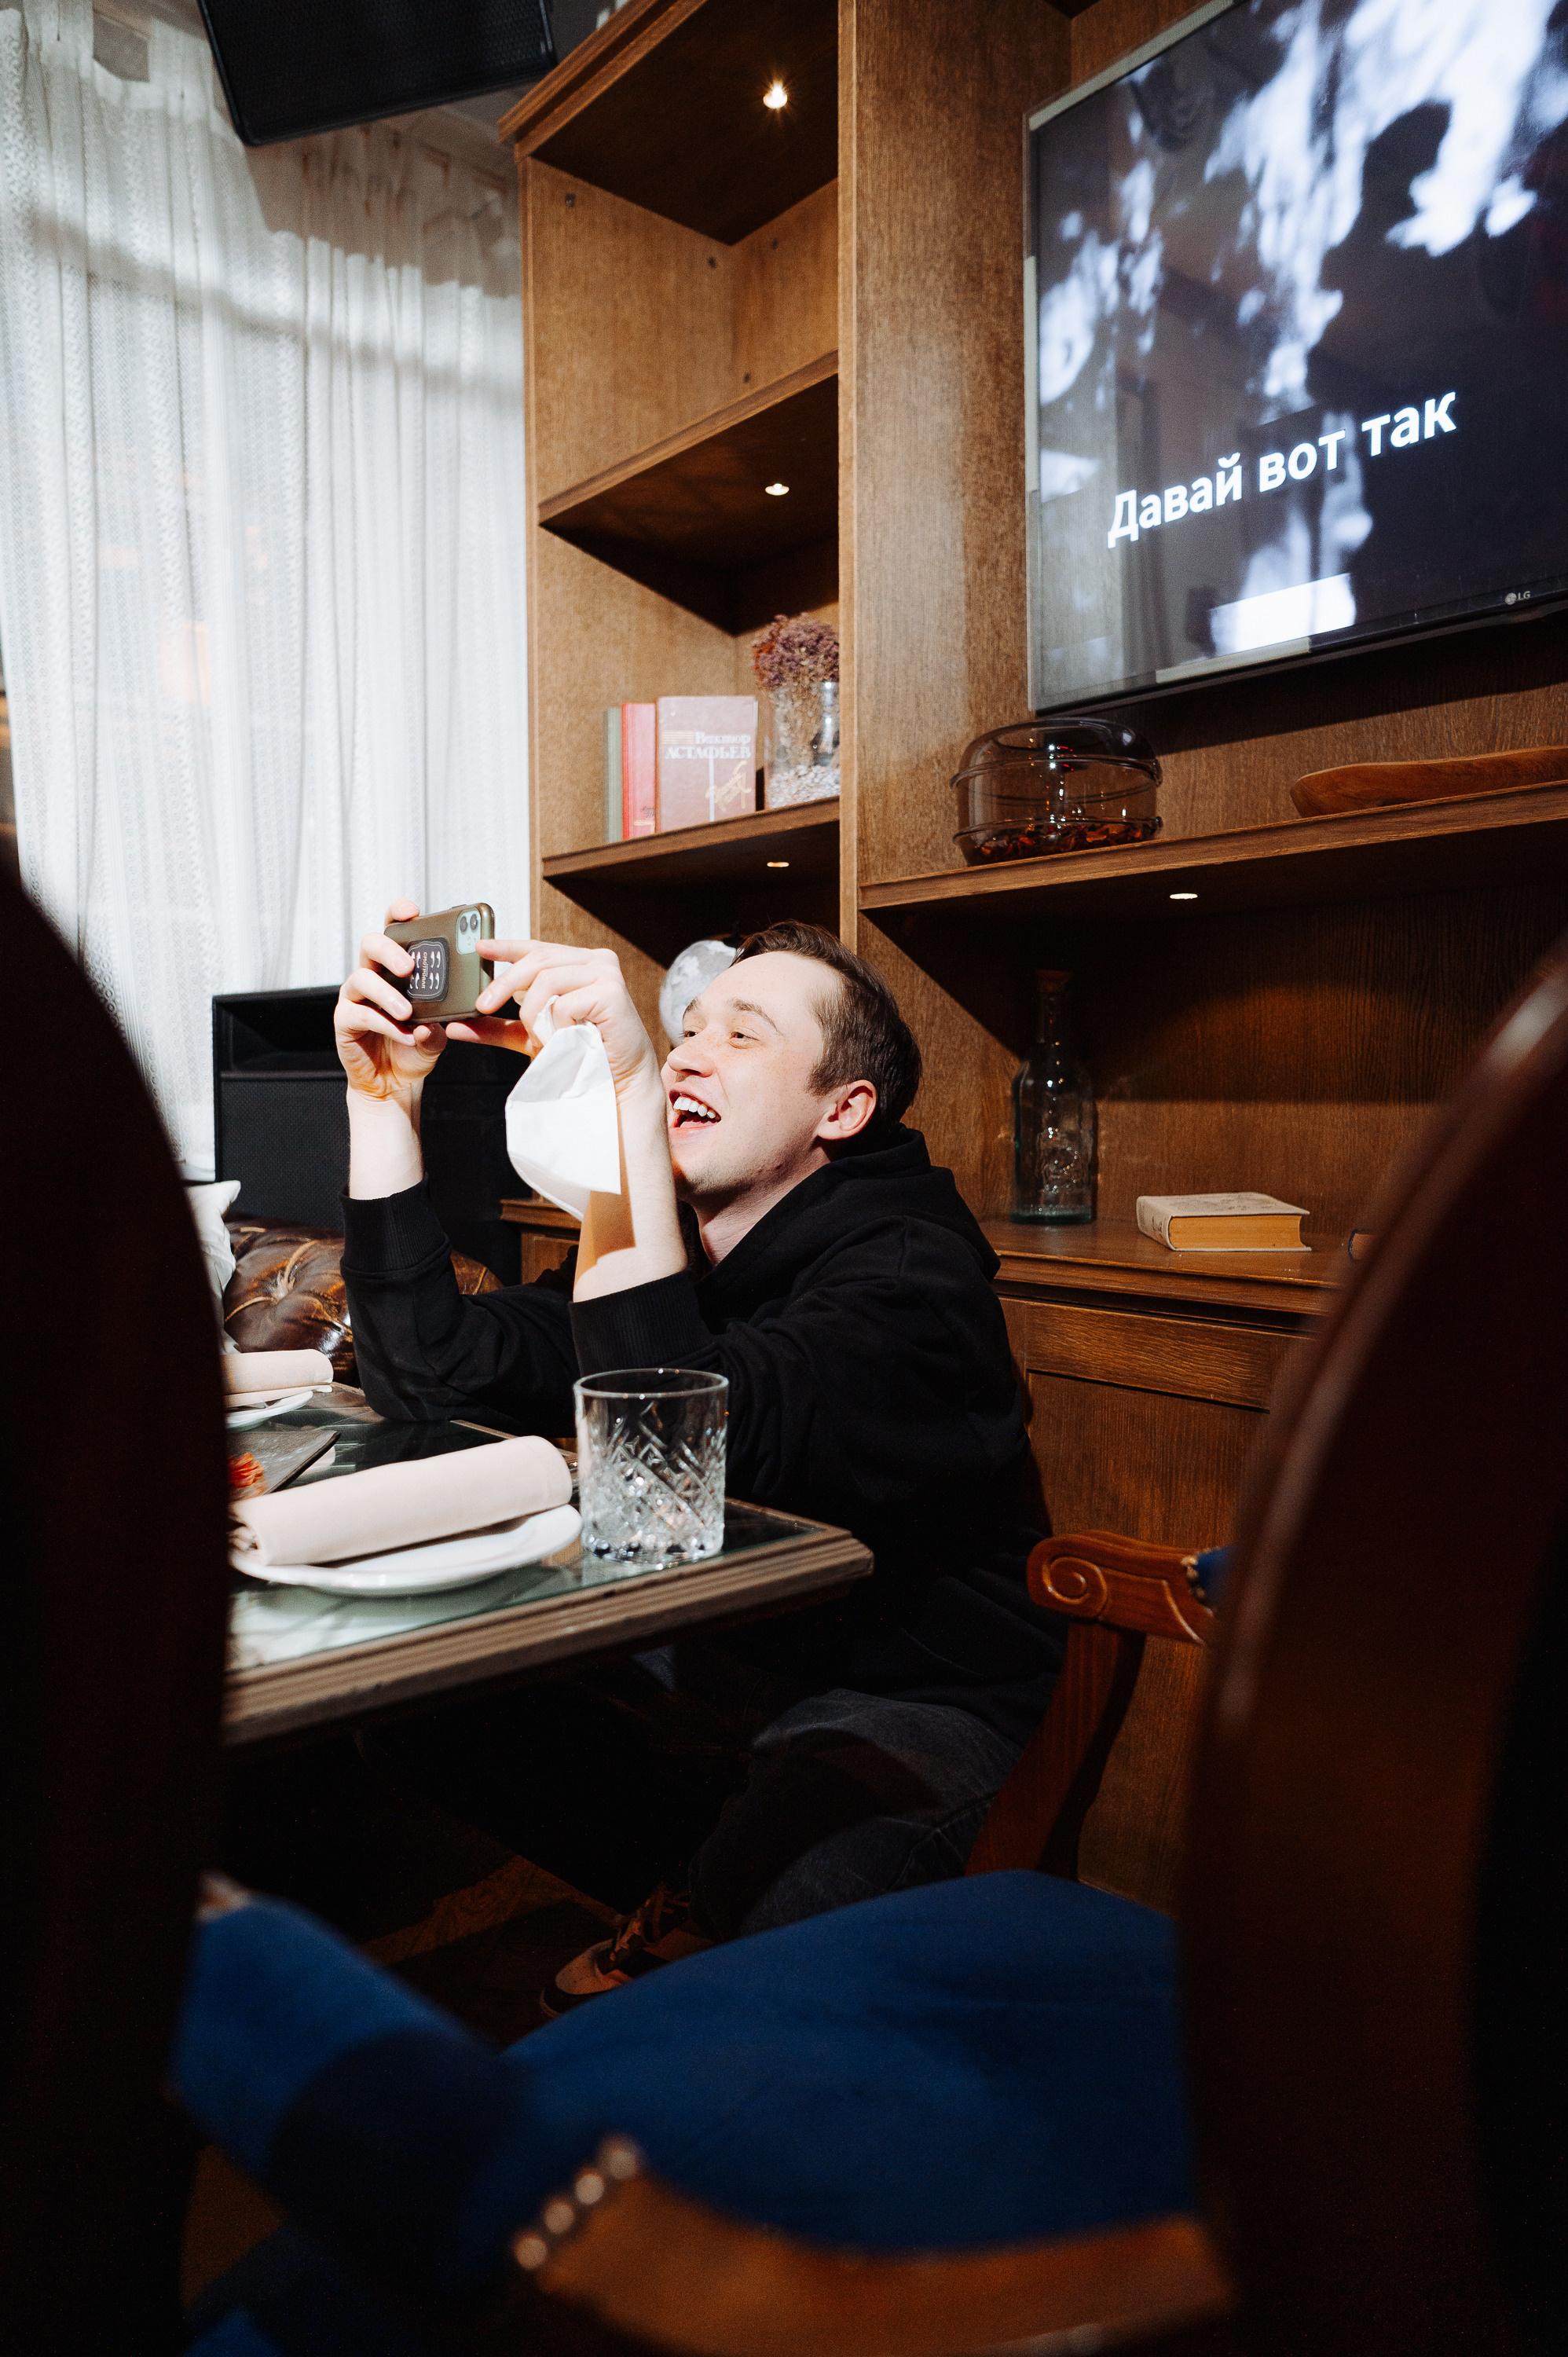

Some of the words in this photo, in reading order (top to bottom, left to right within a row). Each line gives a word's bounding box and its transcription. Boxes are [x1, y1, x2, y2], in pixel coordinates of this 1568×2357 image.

[1107, 453, 1243, 549] Давай
[1258, 430, 1346, 493] вот
[1361, 391, 1457, 457] так
[694, 731, 751, 746] Виктор
[666, 746, 751, 760] АСТАФЬЕВ
